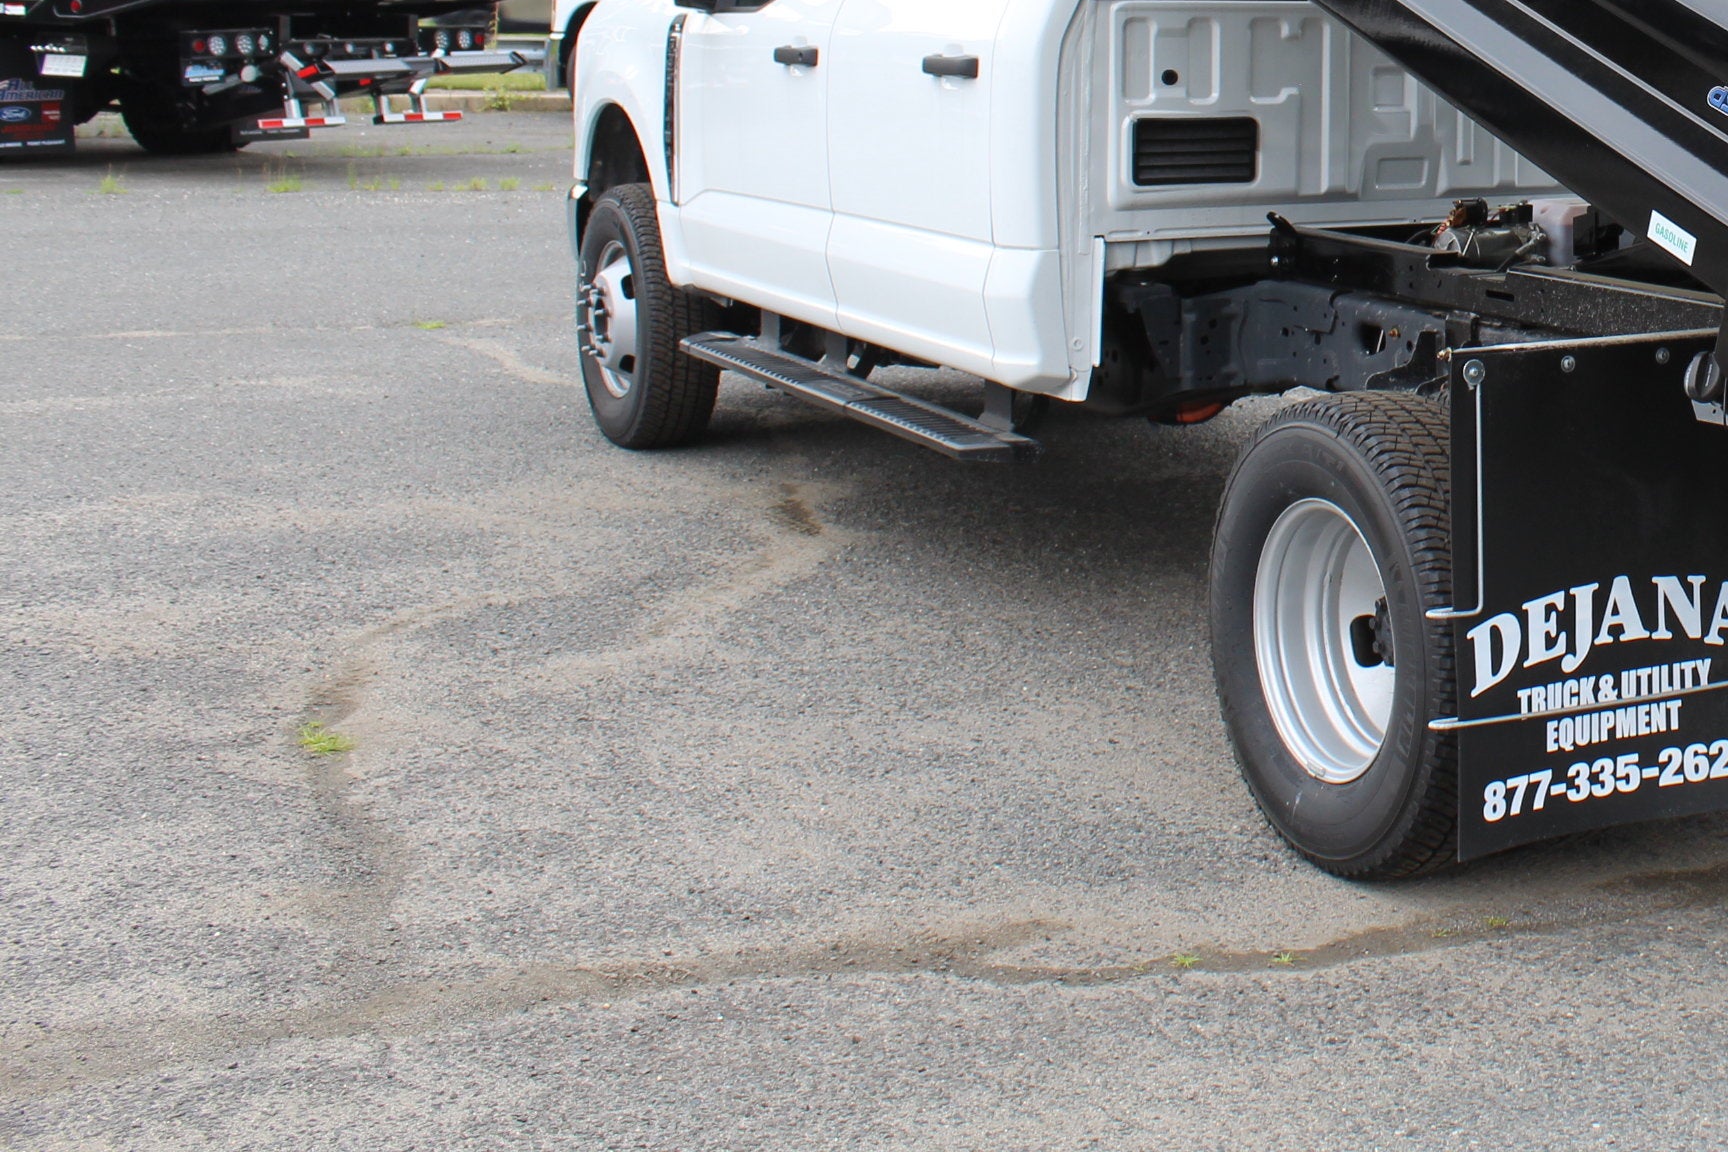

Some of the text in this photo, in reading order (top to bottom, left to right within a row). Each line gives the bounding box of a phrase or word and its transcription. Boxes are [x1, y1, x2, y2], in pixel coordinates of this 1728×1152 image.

[1655, 222, 1689, 253] GASOLINE
[1517, 675, 1596, 714] TRUCK
[1620, 658, 1712, 698] UTILITY
[1546, 699, 1682, 753] EQUIPMENT
